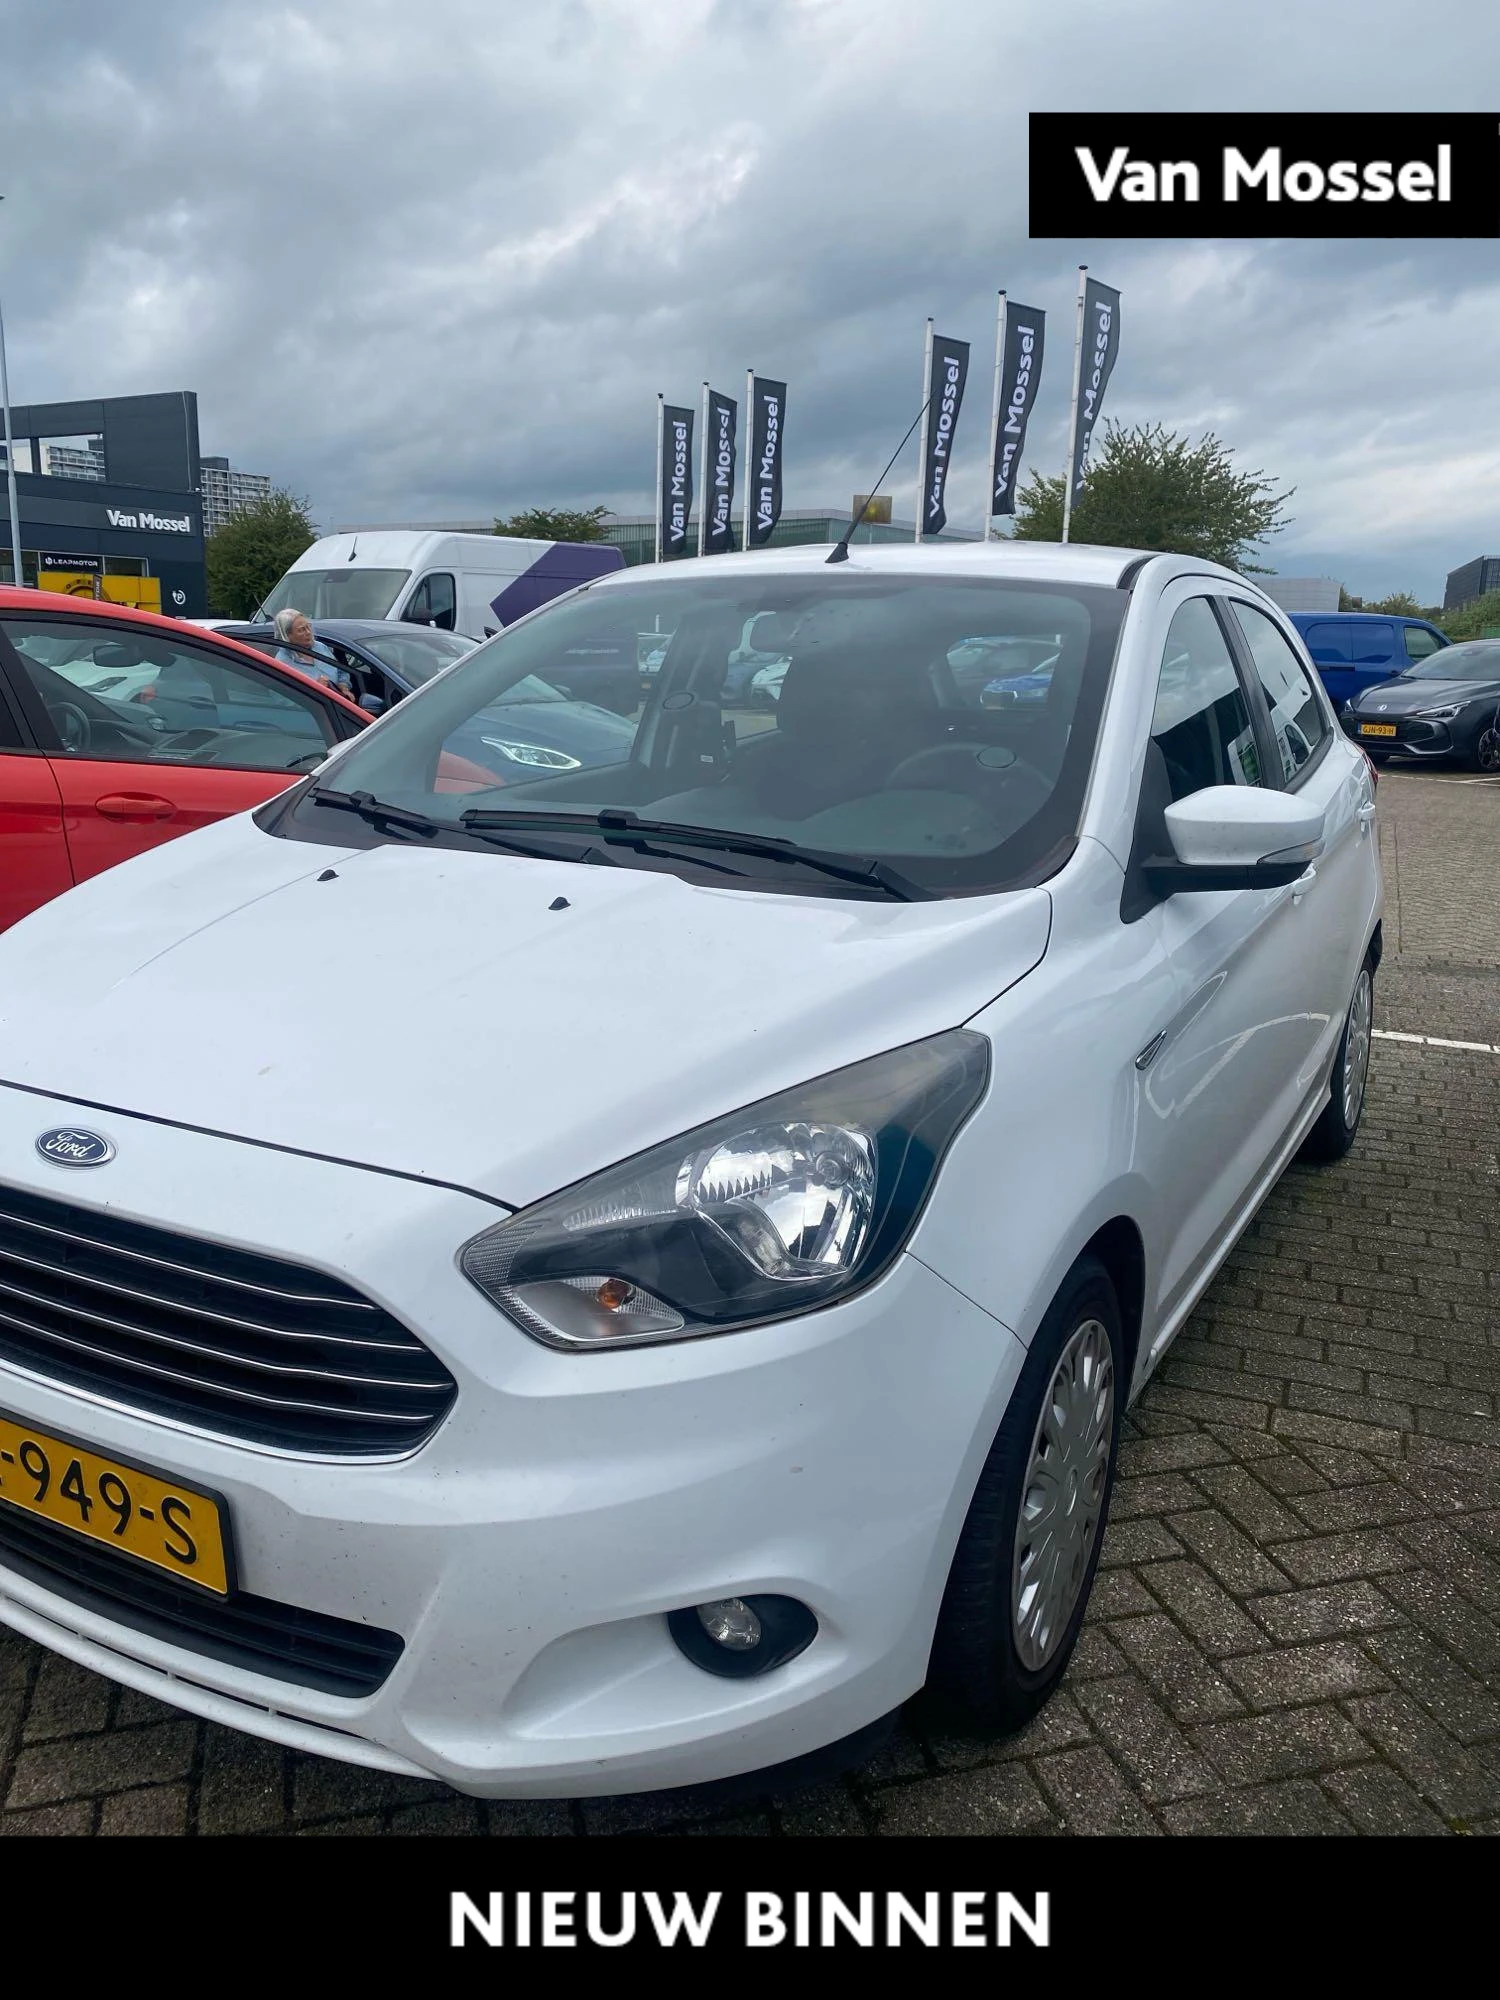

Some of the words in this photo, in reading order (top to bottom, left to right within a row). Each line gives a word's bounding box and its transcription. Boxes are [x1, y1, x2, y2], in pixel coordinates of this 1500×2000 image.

[1004, 325, 1035, 434] Mossel
[1084, 301, 1112, 420] Mossel
[934, 356, 959, 457] Mossel
[671, 421, 687, 496] Mossel
[760, 395, 779, 479] Mossel
[930, 466, 943, 518] Van
[995, 442, 1018, 498] Van
[106, 509, 137, 528] Van
[139, 512, 190, 532] Mossel
[670, 502, 685, 541] Van
[712, 493, 729, 536] Van
[757, 486, 773, 530] Van
[45, 1131, 96, 1158] Ford
[0, 1440, 198, 1565] -949-S
